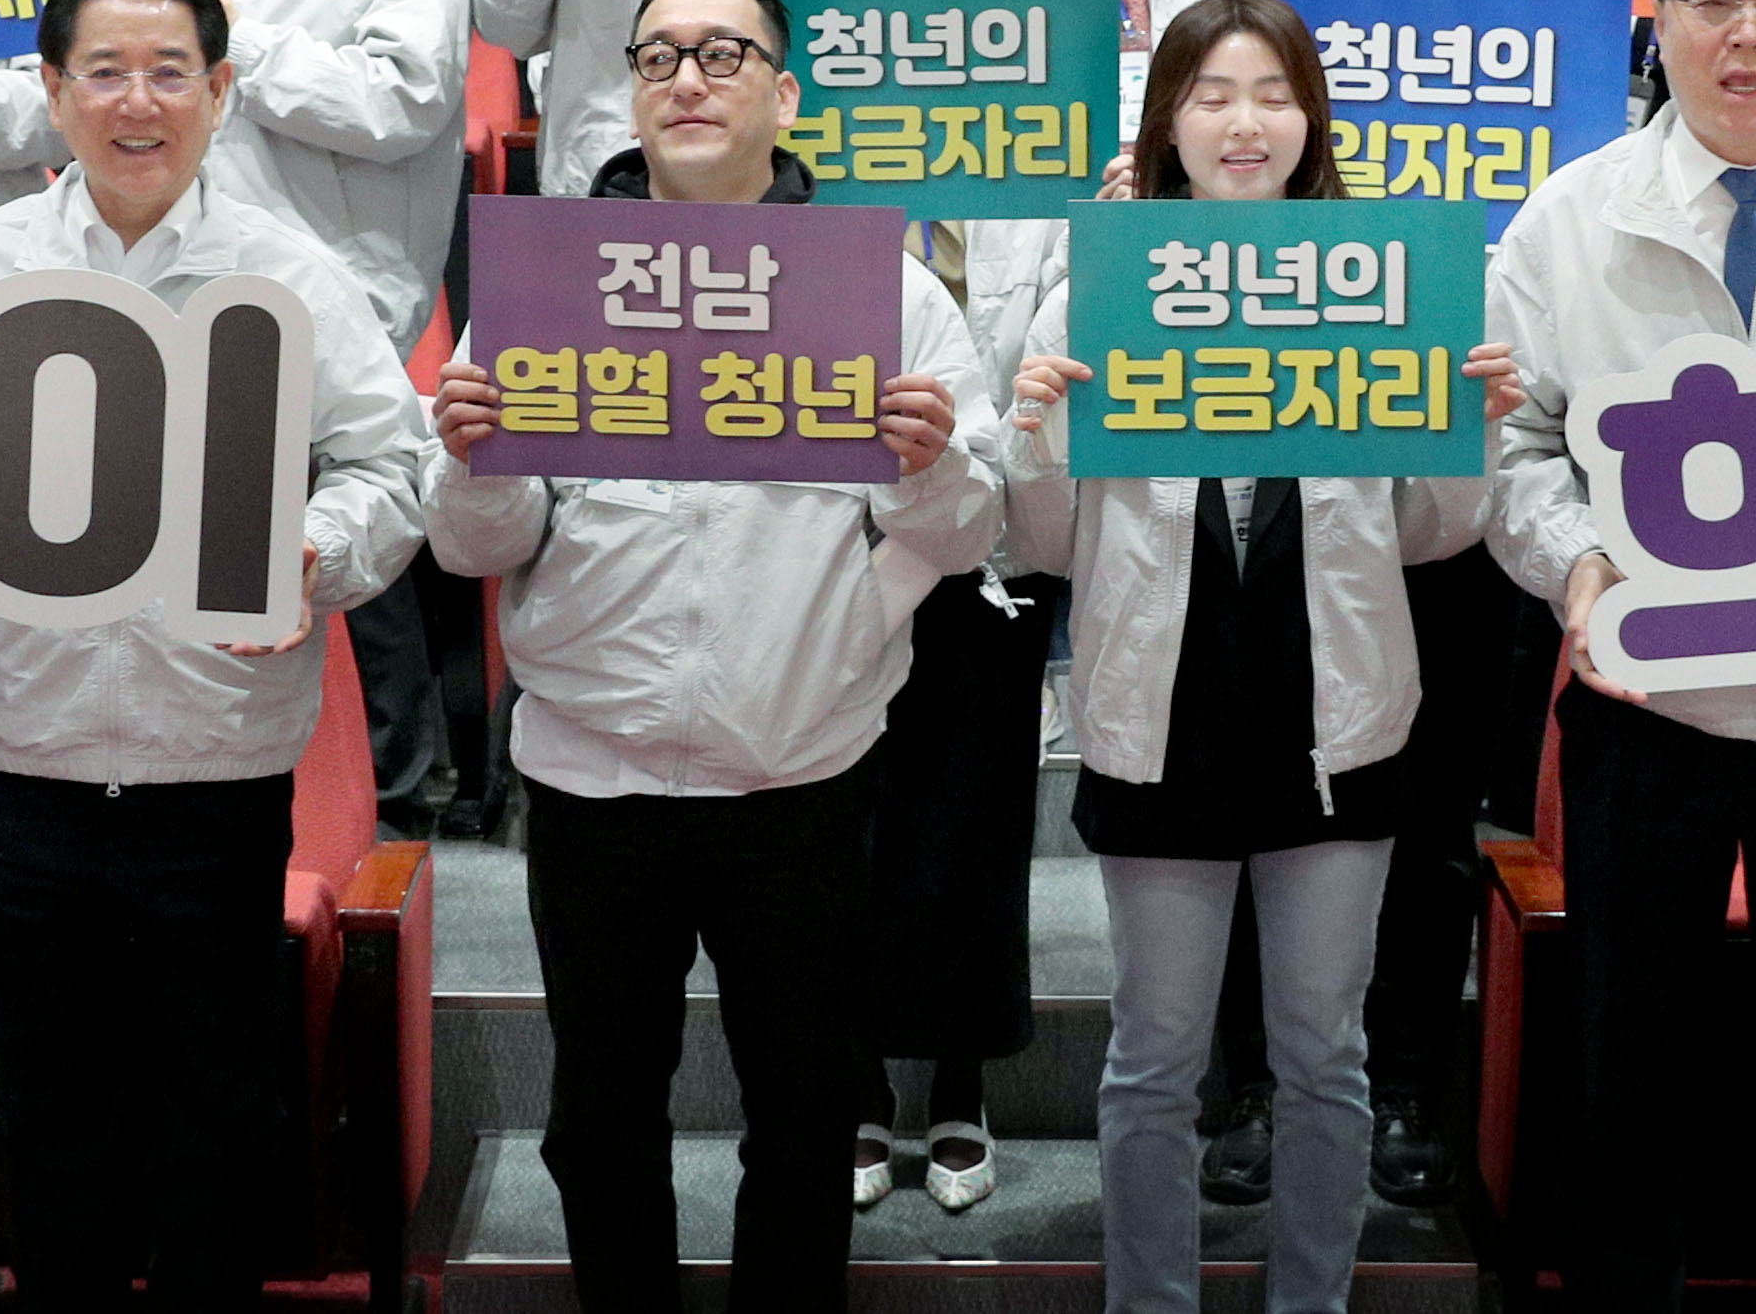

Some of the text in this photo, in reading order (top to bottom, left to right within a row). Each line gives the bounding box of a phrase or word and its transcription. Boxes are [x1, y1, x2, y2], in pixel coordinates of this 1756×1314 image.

[804, 5, 1048, 88] 청년의
[1314, 19, 1556, 109] 청년의
[787, 99, 1092, 182] 보금자리
[1329, 120, 1554, 200] 일자리
[595, 240, 781, 334] 전남
[1145, 238, 1410, 329] 청년의
[493, 345, 878, 442] 열혈 청년
[1101, 345, 1452, 433] 보금자리
